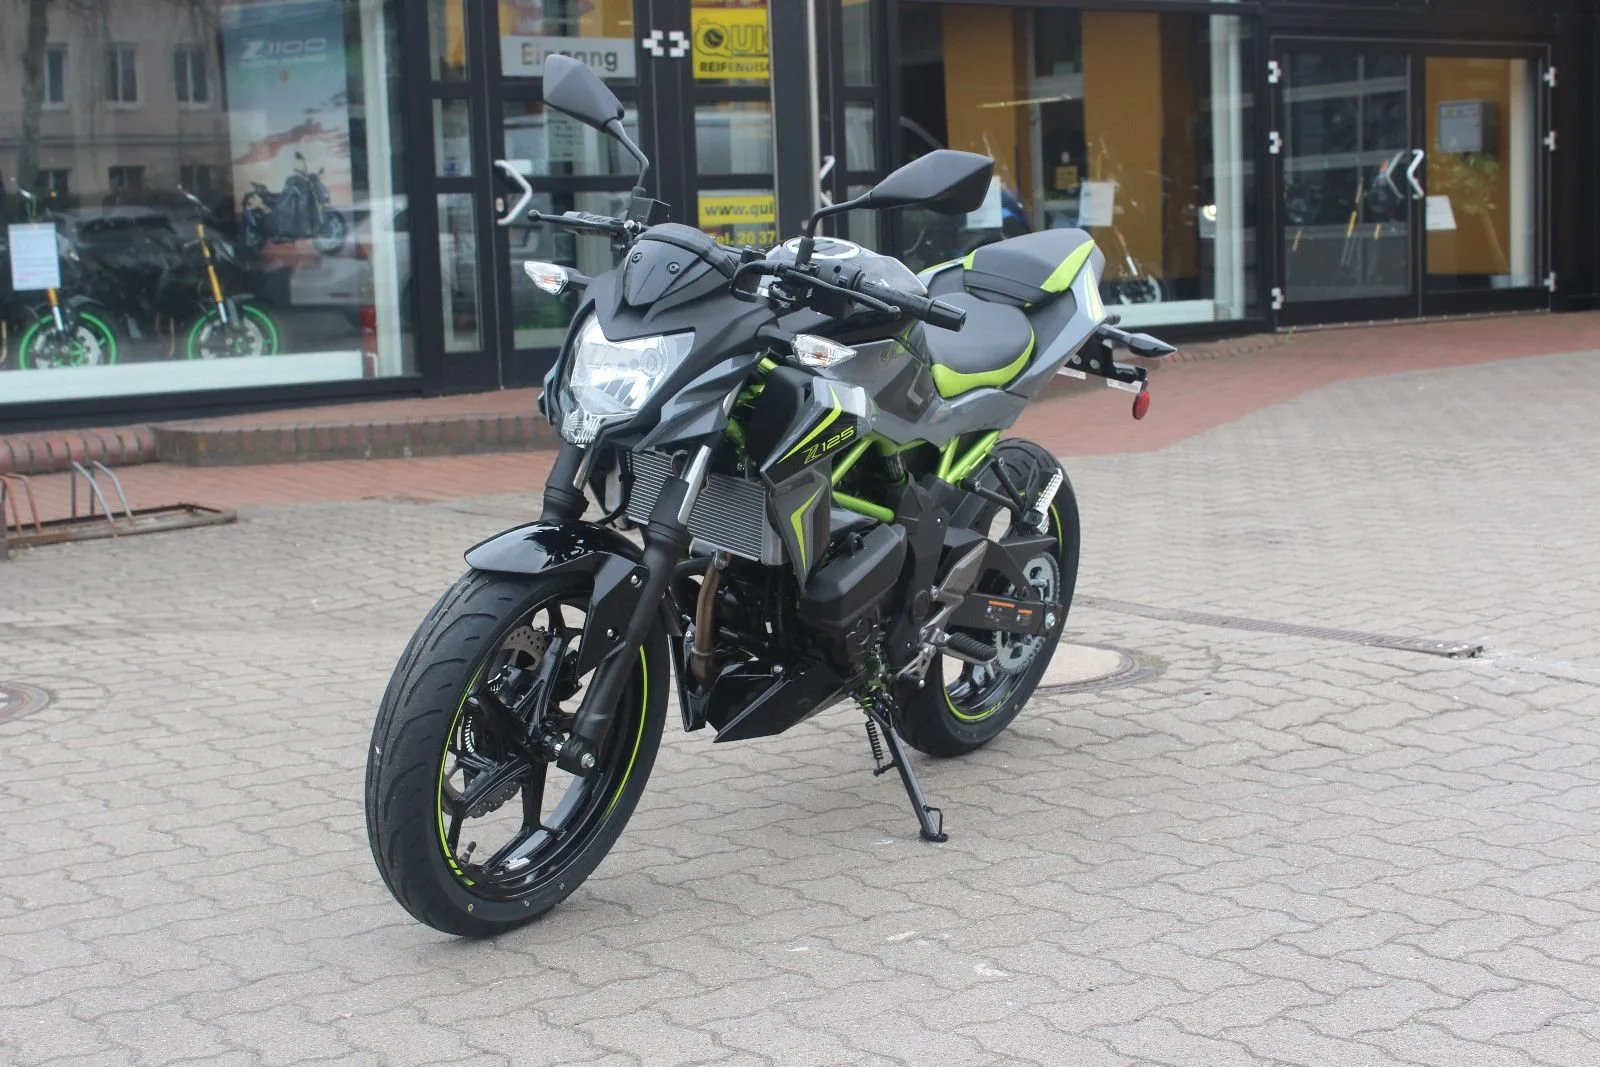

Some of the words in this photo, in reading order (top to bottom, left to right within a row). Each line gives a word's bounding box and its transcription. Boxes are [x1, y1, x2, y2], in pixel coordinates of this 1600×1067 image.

[695, 18, 768, 58] QUI
[521, 42, 618, 71] Eiang
[738, 231, 755, 245] 20
[759, 230, 776, 245] 37
